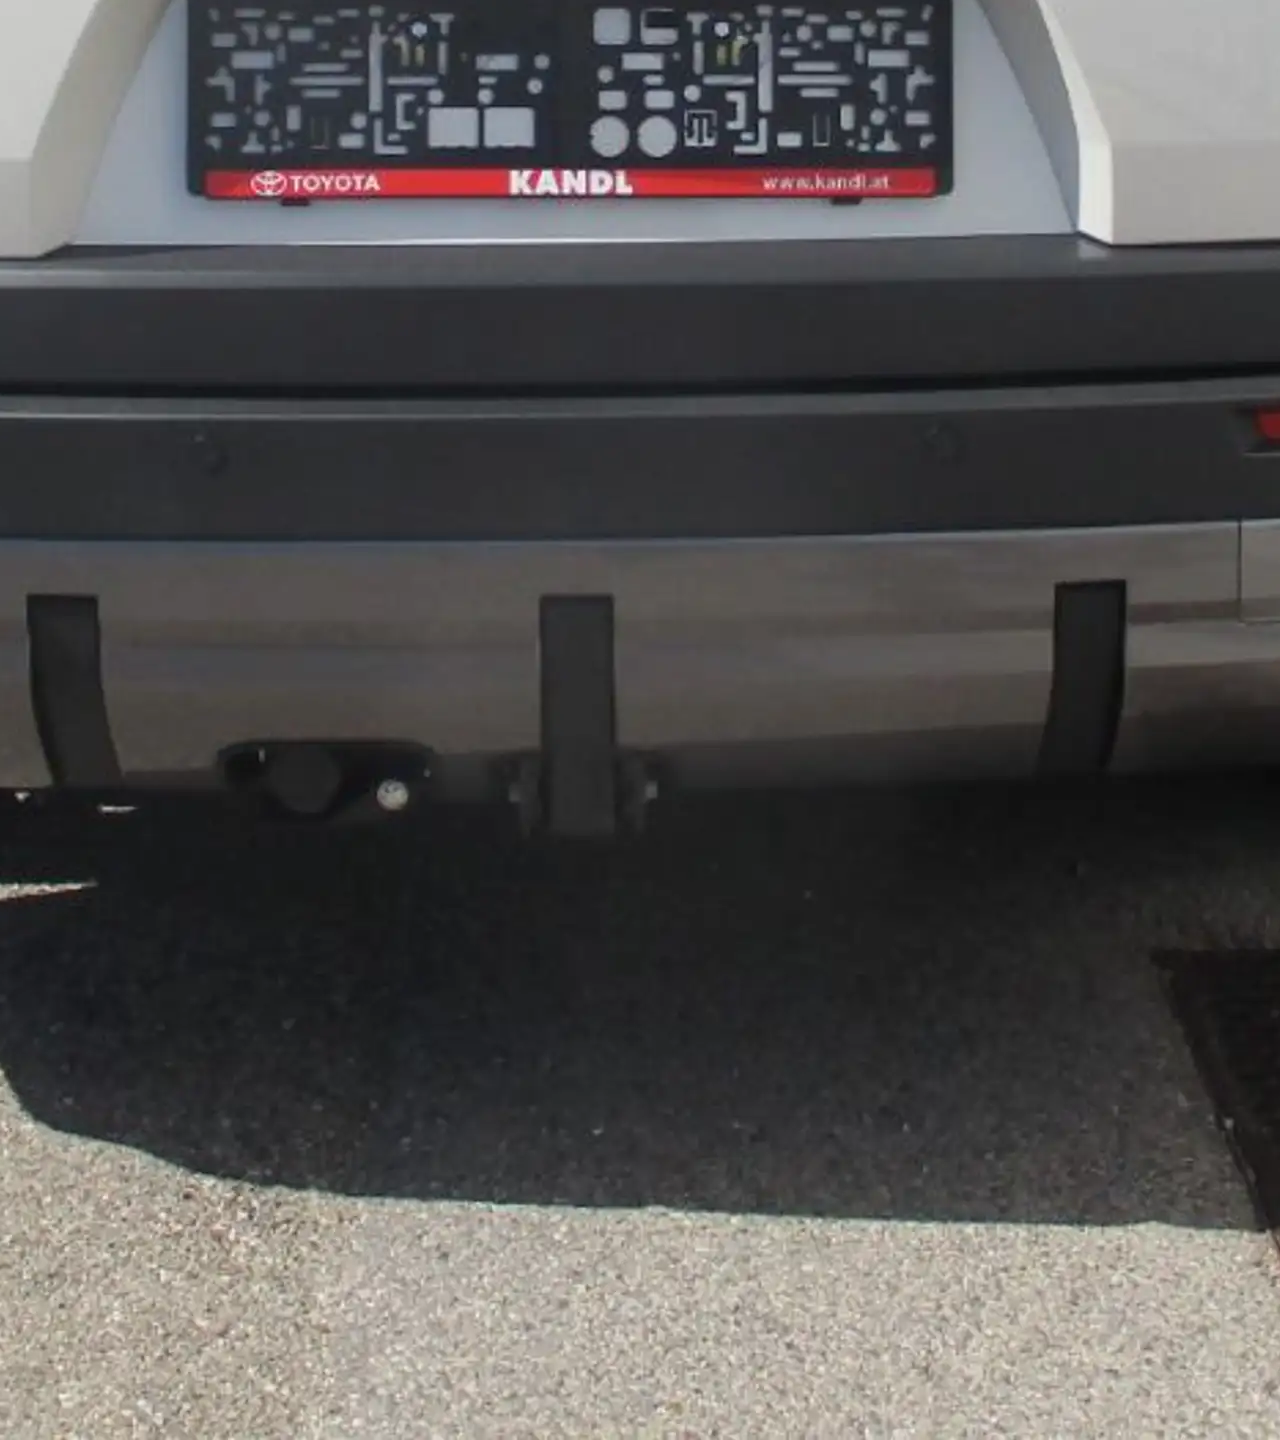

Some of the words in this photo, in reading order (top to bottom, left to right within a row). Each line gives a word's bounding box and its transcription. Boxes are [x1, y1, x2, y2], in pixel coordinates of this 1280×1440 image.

[290, 172, 381, 192] TOYOTA
[508, 169, 633, 195] KANDL
[762, 172, 889, 191] www.kandl.at
